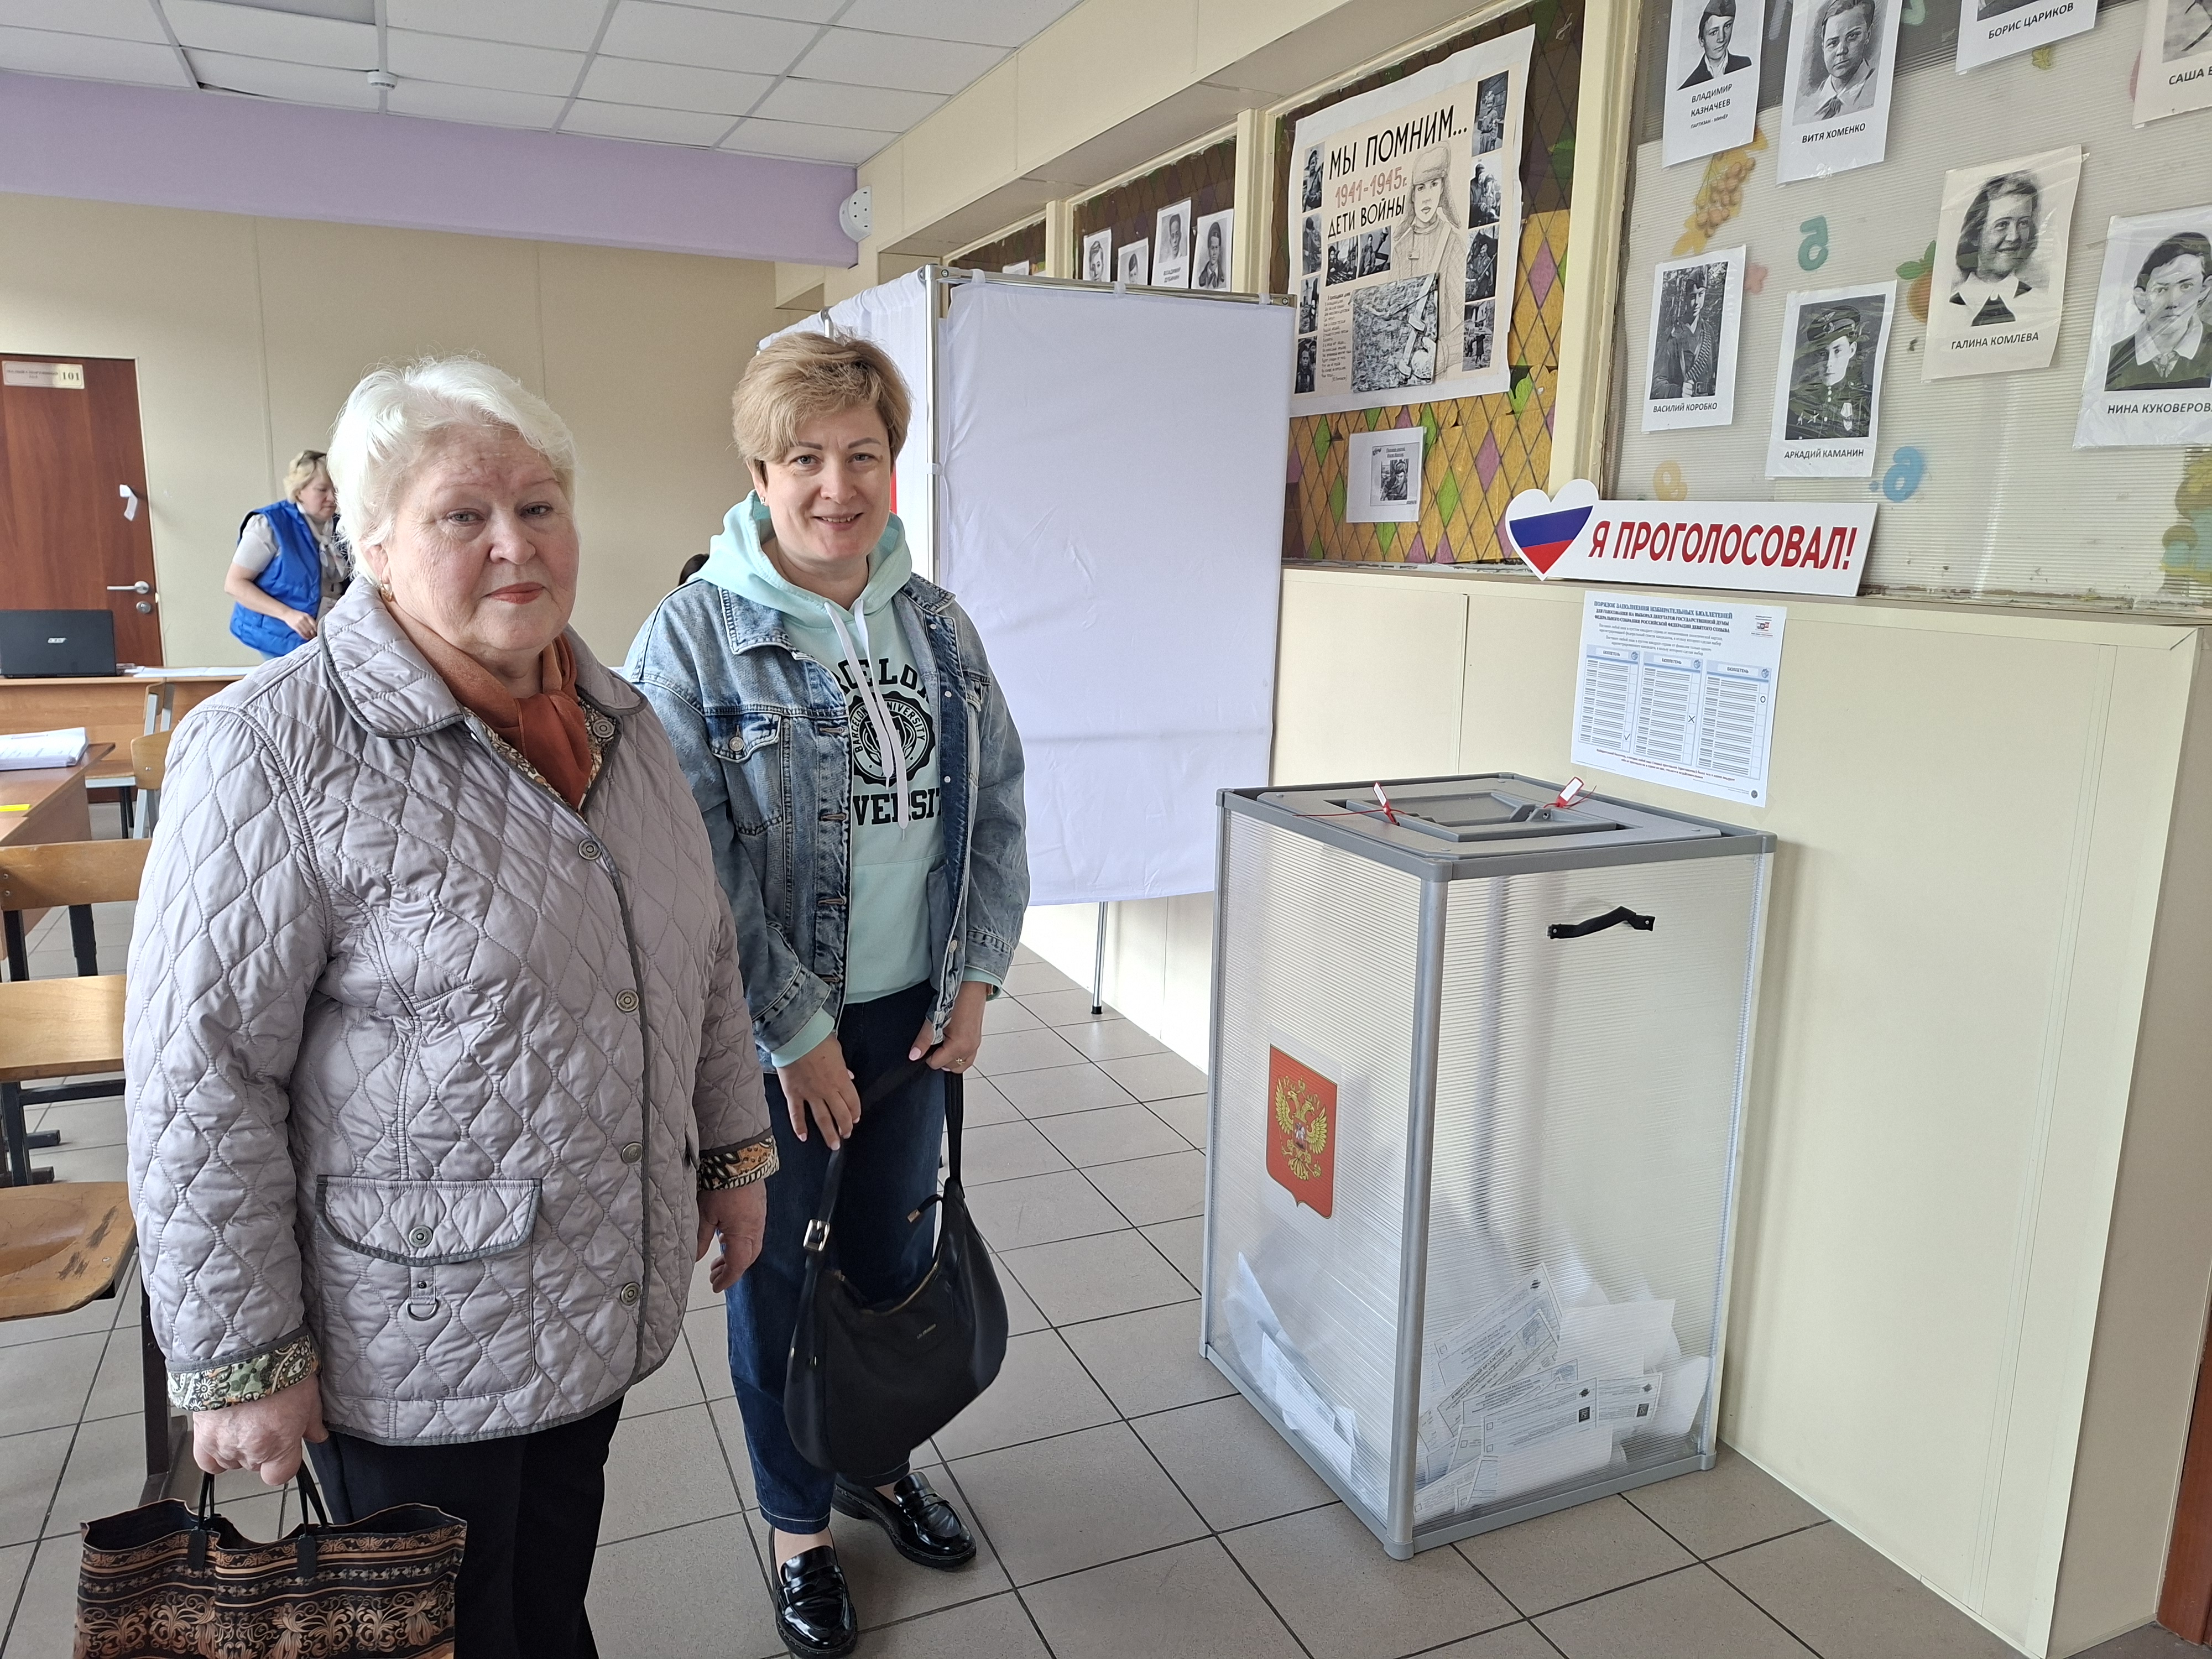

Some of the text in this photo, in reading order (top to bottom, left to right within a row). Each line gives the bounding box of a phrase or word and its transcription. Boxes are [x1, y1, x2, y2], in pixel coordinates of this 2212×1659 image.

[1988, 2, 2074, 40] БОРИС ЦАРИКОВ
[2169, 68, 2204, 85] САША
[1692, 84, 1733, 103] ВЛАДИМИР
[1691, 98, 1730, 117] КАЗНАЧЕЕВ
[1691, 119, 1711, 128] ПАРТИЗАН
[1329, 105, 1467, 180] МЫ ПОМНИМ...
[1802, 123, 1866, 144] ВИТЯ ХОМЕНКО
[1327, 195, 1406, 241] ДЕТИ ВОЙНЫ
[1951, 332, 2039, 349] ГАЛИНА КОМЛЕВА
[62, 371, 80, 381] 101
[1652, 401, 1718, 413] ВАСИЛИЙ КОРОБКО
[2107, 403, 2212, 414] НИНА КУКОВЕРОВ
[1784, 448, 1864, 460] АРКАДИЙ КАМАНИН
[1588, 520, 1858, 570] Я ПРОГОЛОСОВАЛ!
[1616, 603, 1649, 612] ЗАПОЛНЕНИЯ
[1650, 606, 1694, 616] ИЗБИРАТЕЛЬНЫХ
[1695, 610, 1733, 619] БЮЛЛЕТЕНЕЙ
[886, 701, 925, 741] NIVERSITY
